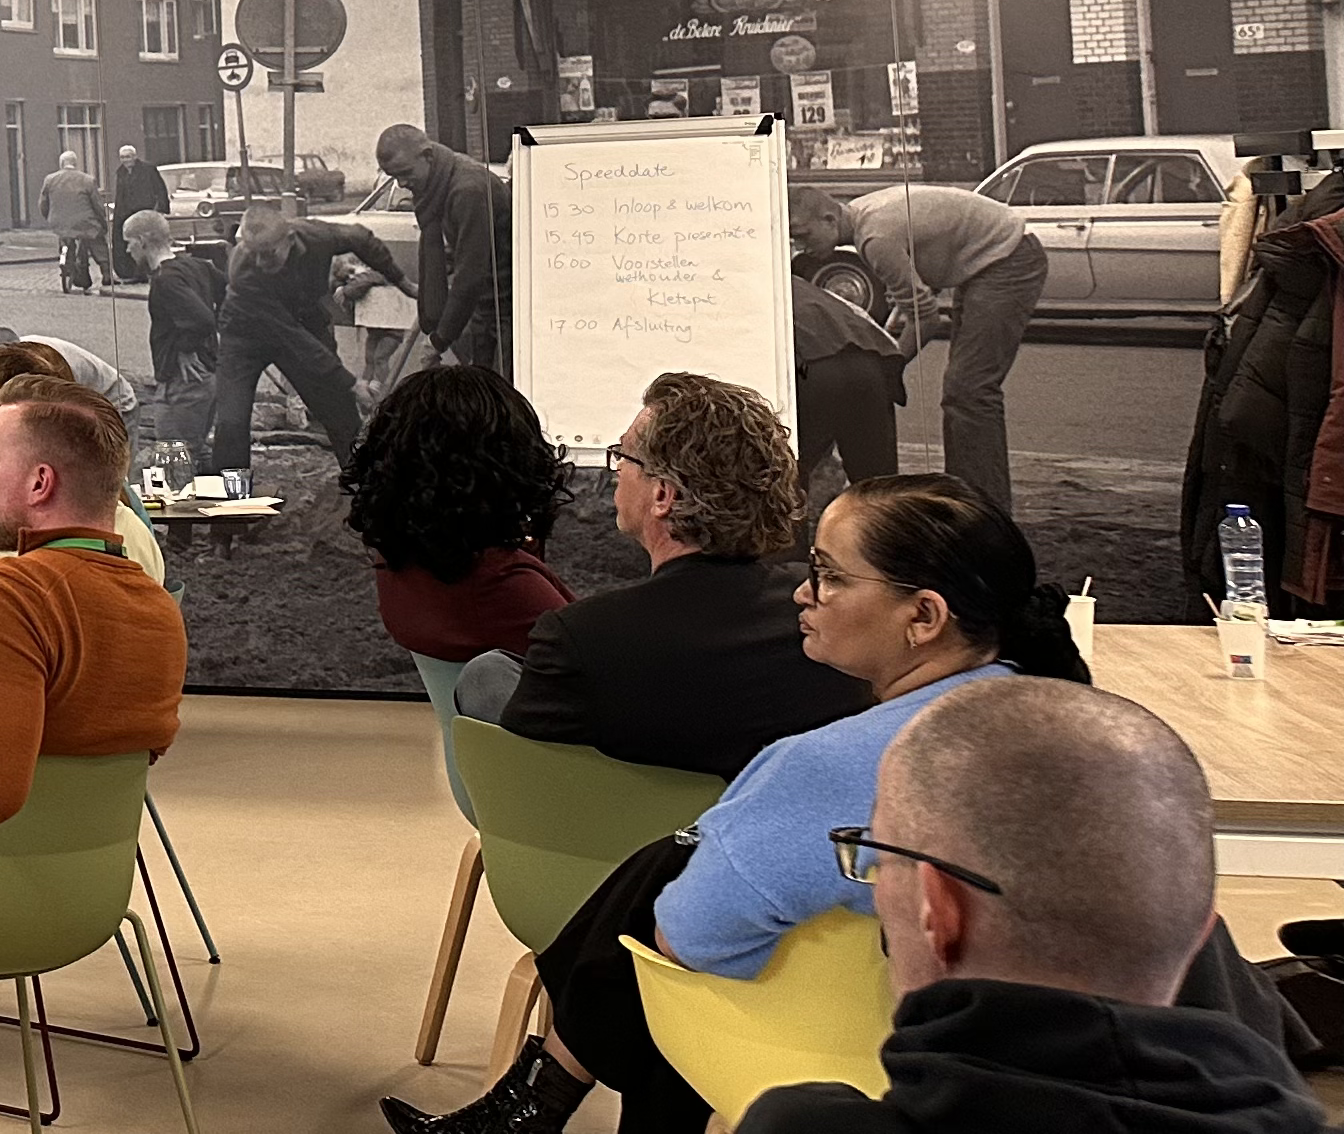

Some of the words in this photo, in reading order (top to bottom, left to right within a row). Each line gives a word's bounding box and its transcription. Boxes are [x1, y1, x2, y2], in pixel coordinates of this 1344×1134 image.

[800, 106, 826, 124] 129
[564, 162, 676, 190] Speeddate
[614, 197, 661, 220] Inloop
[686, 196, 753, 213] welkom
[614, 226, 664, 245] Korte
[612, 254, 700, 271] Voorstellen
[616, 270, 697, 283] wethouder
[712, 269, 726, 281] &
[612, 315, 693, 343] Afsluiting
